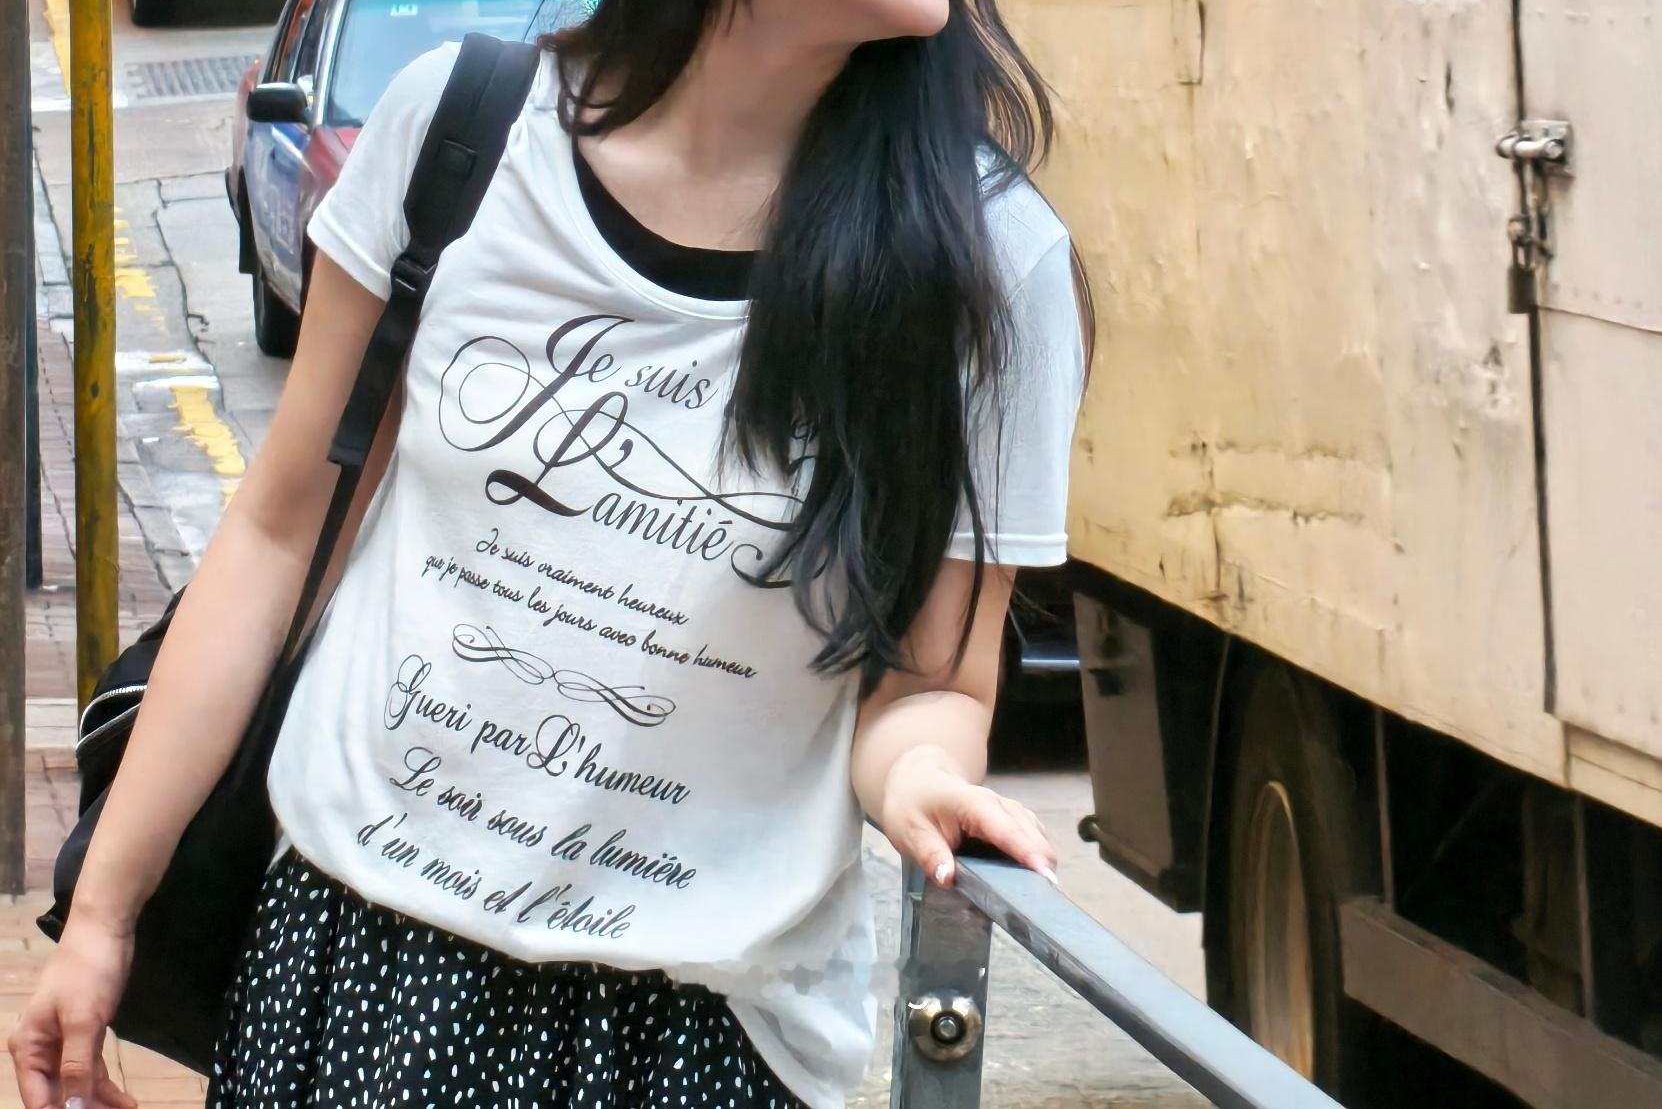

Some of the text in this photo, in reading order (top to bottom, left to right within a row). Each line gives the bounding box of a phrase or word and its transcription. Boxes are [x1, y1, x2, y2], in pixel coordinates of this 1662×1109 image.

[439, 314, 720, 452] Je suis
[420, 555, 446, 578] que
[438, 555, 460, 582] je
[453, 567, 491, 589] passe
[492, 580, 525, 602] tous
[527, 585, 552, 613] les
[542, 603, 599, 630] jours
[641, 629, 691, 665] bonne
[692, 643, 760, 679] humeur
[476, 527, 690, 626] Je suis vraiment heureux
[383, 653, 692, 805] Gueri par L'humeur
[357, 812, 420, 868] d'un
[483, 881, 533, 914] et
[388, 746, 442, 797] Le
[437, 785, 484, 823] soir
[486, 808, 549, 848] sous
[551, 823, 593, 861] la
